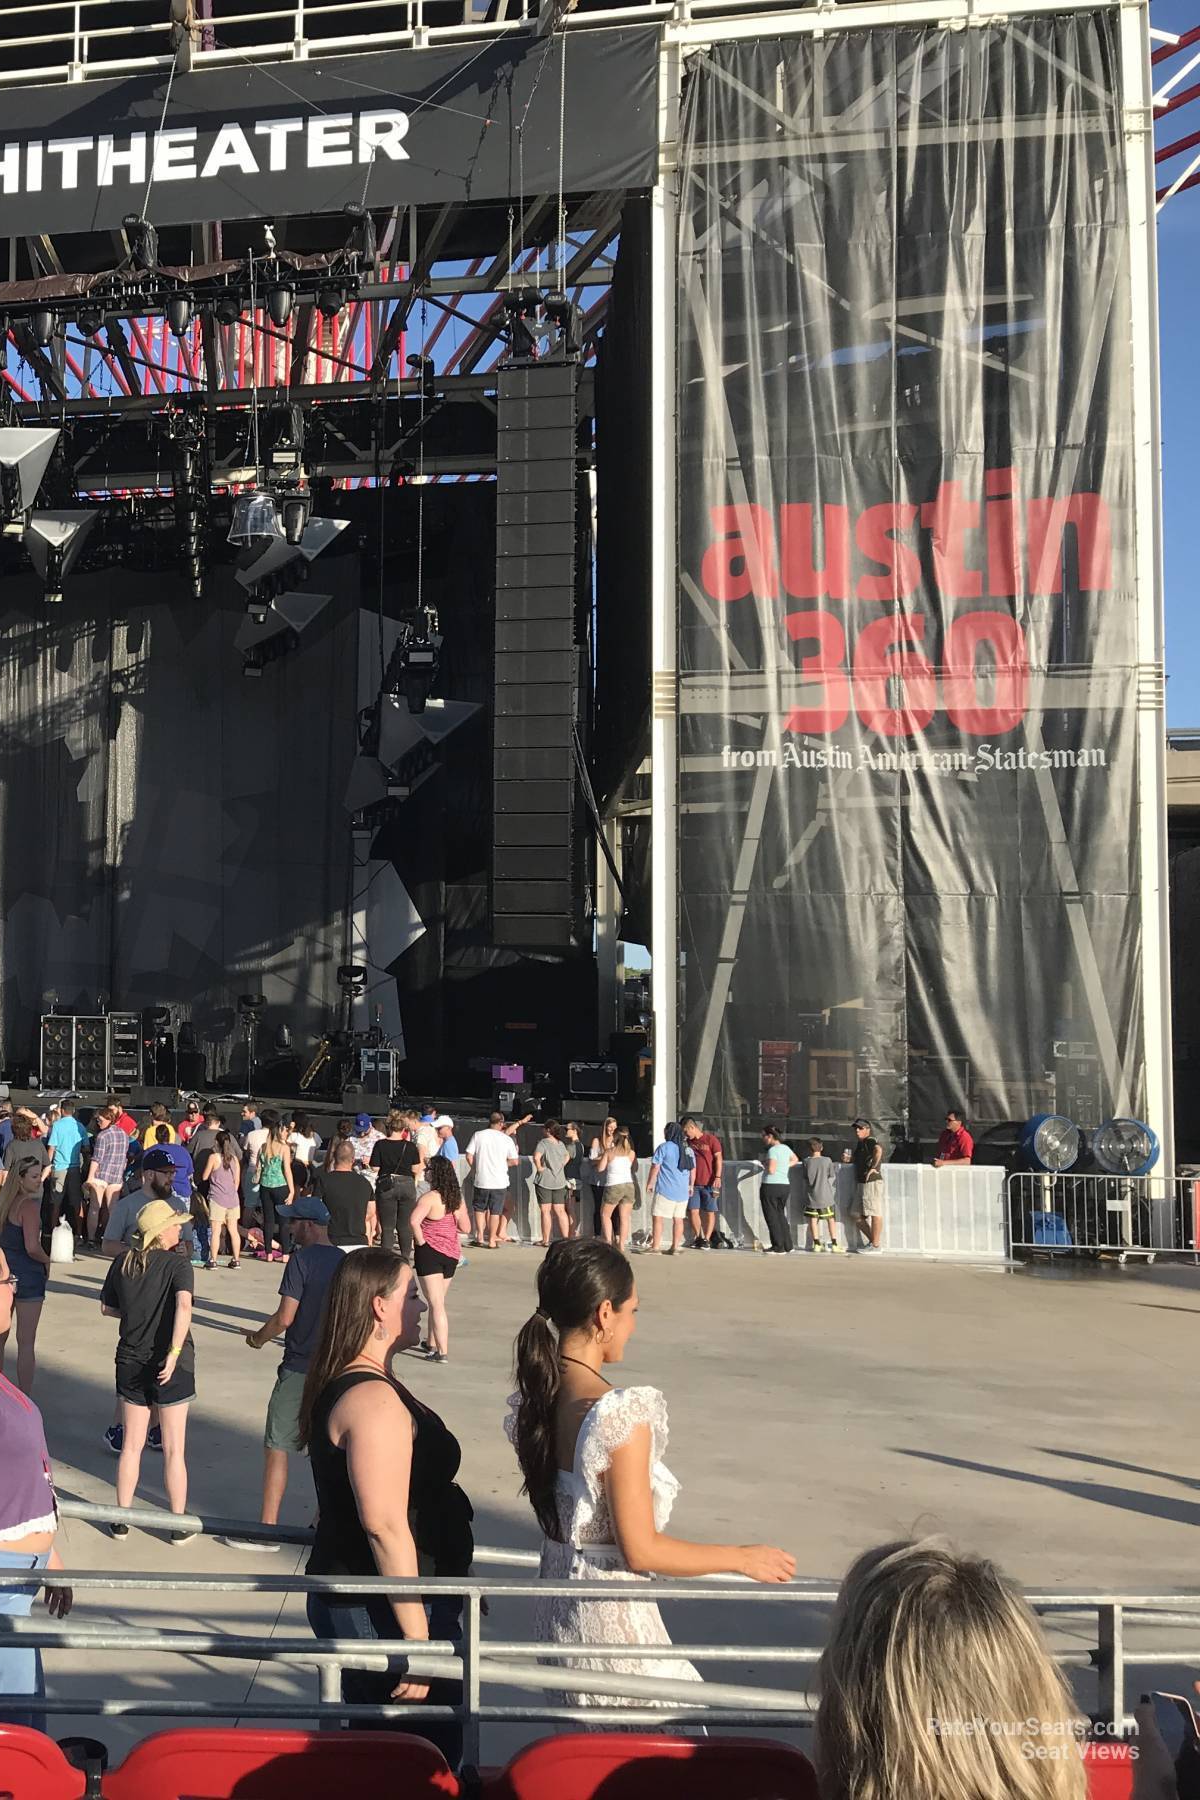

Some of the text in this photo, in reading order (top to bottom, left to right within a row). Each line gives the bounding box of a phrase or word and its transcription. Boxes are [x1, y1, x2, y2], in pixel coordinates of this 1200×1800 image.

[701, 466, 1113, 602] austin
[783, 610, 1031, 736] 360
[721, 744, 777, 768] from
[779, 742, 853, 771] Austin
